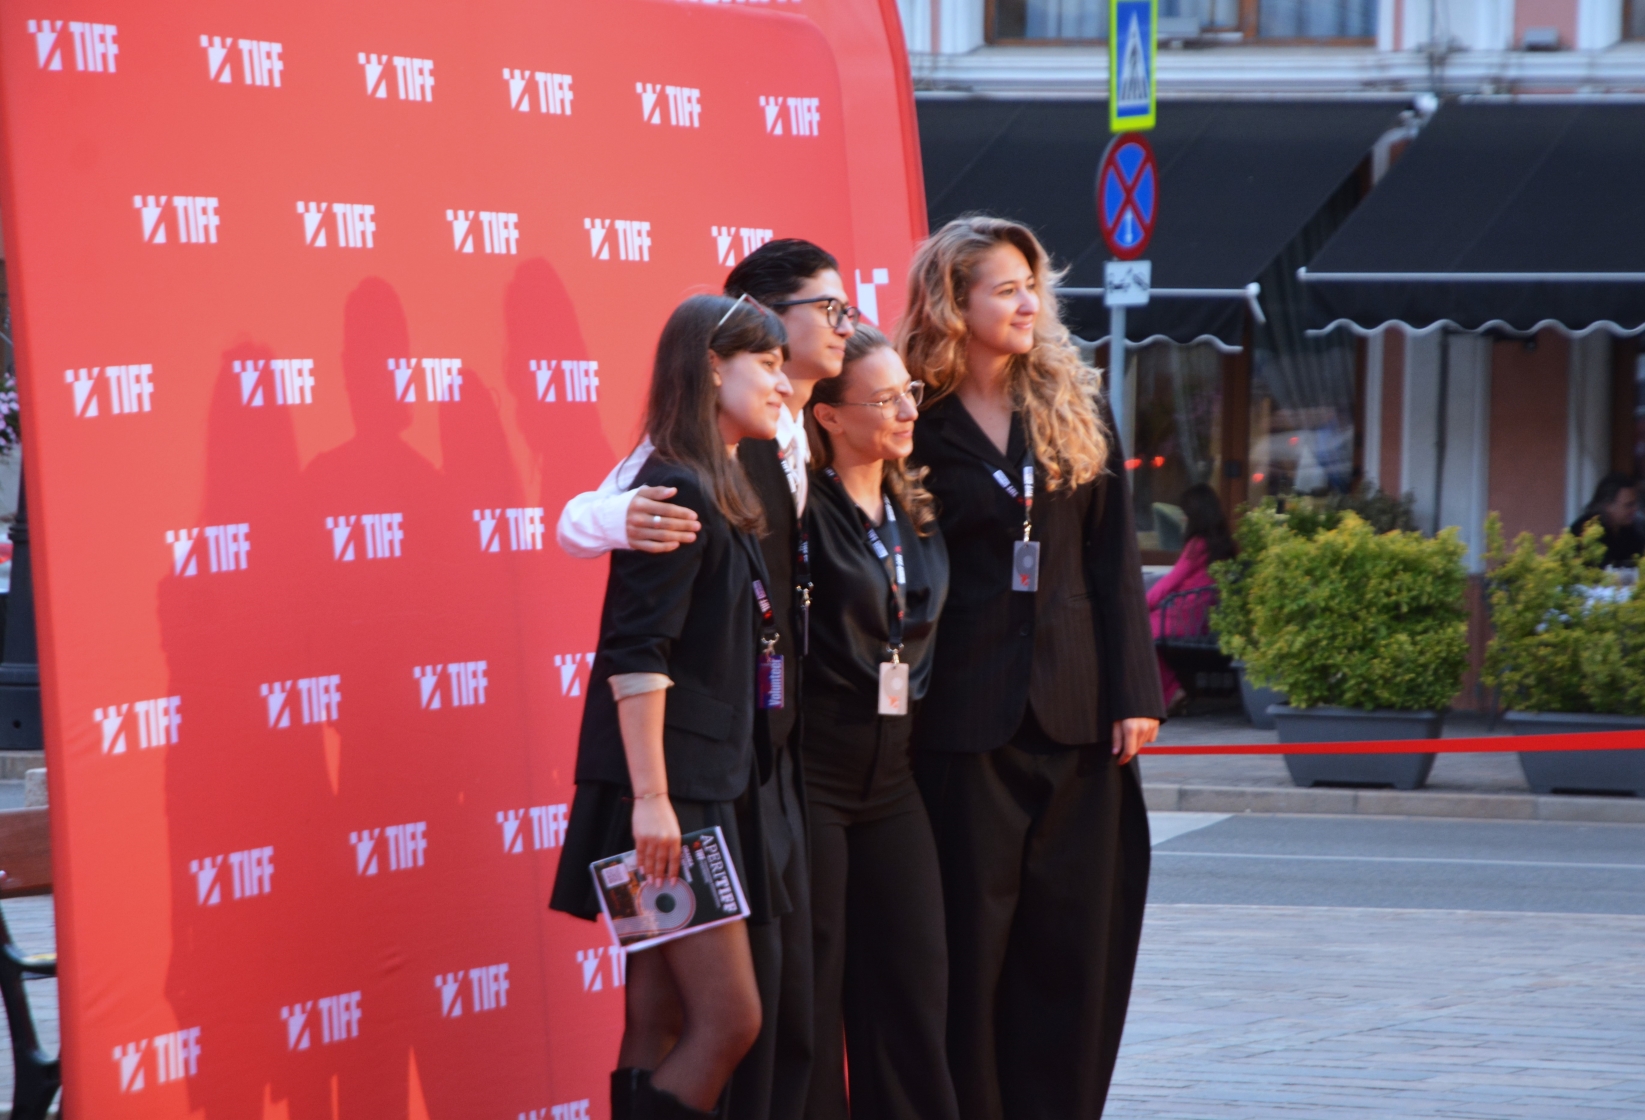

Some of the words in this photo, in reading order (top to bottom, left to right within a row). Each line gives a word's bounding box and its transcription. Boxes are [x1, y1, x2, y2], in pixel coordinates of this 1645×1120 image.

[69, 22, 118, 72] TIFF
[238, 39, 283, 87] TIFF
[393, 56, 434, 101] TIFF
[535, 72, 573, 115] TIFF
[665, 86, 701, 127] TIFF
[787, 98, 820, 135] TIFF
[173, 196, 219, 243] TIFF
[333, 203, 375, 248] TIFF
[479, 212, 519, 254] TIFF
[615, 220, 651, 261] TIFF
[106, 364, 153, 414] TIFF
[271, 359, 314, 404] TIFF
[422, 358, 462, 401] TIFF
[562, 361, 599, 402] TIFF
[204, 523, 250, 572] TIFF
[361, 513, 403, 558] TIFF
[506, 507, 544, 550] TIFF
[297, 675, 340, 723] TIFF
[448, 661, 487, 706] TIFF
[768, 658, 782, 707] Volunteer
[134, 697, 180, 748] TIFF
[385, 822, 427, 870] TIFF
[529, 804, 567, 849] TIFF
[229, 846, 273, 898] TIFF
[700, 835, 738, 912] APERITIFF
[469, 963, 509, 1011] TIFF
[318, 991, 361, 1043] TIFF
[153, 1027, 200, 1083] TIFF
